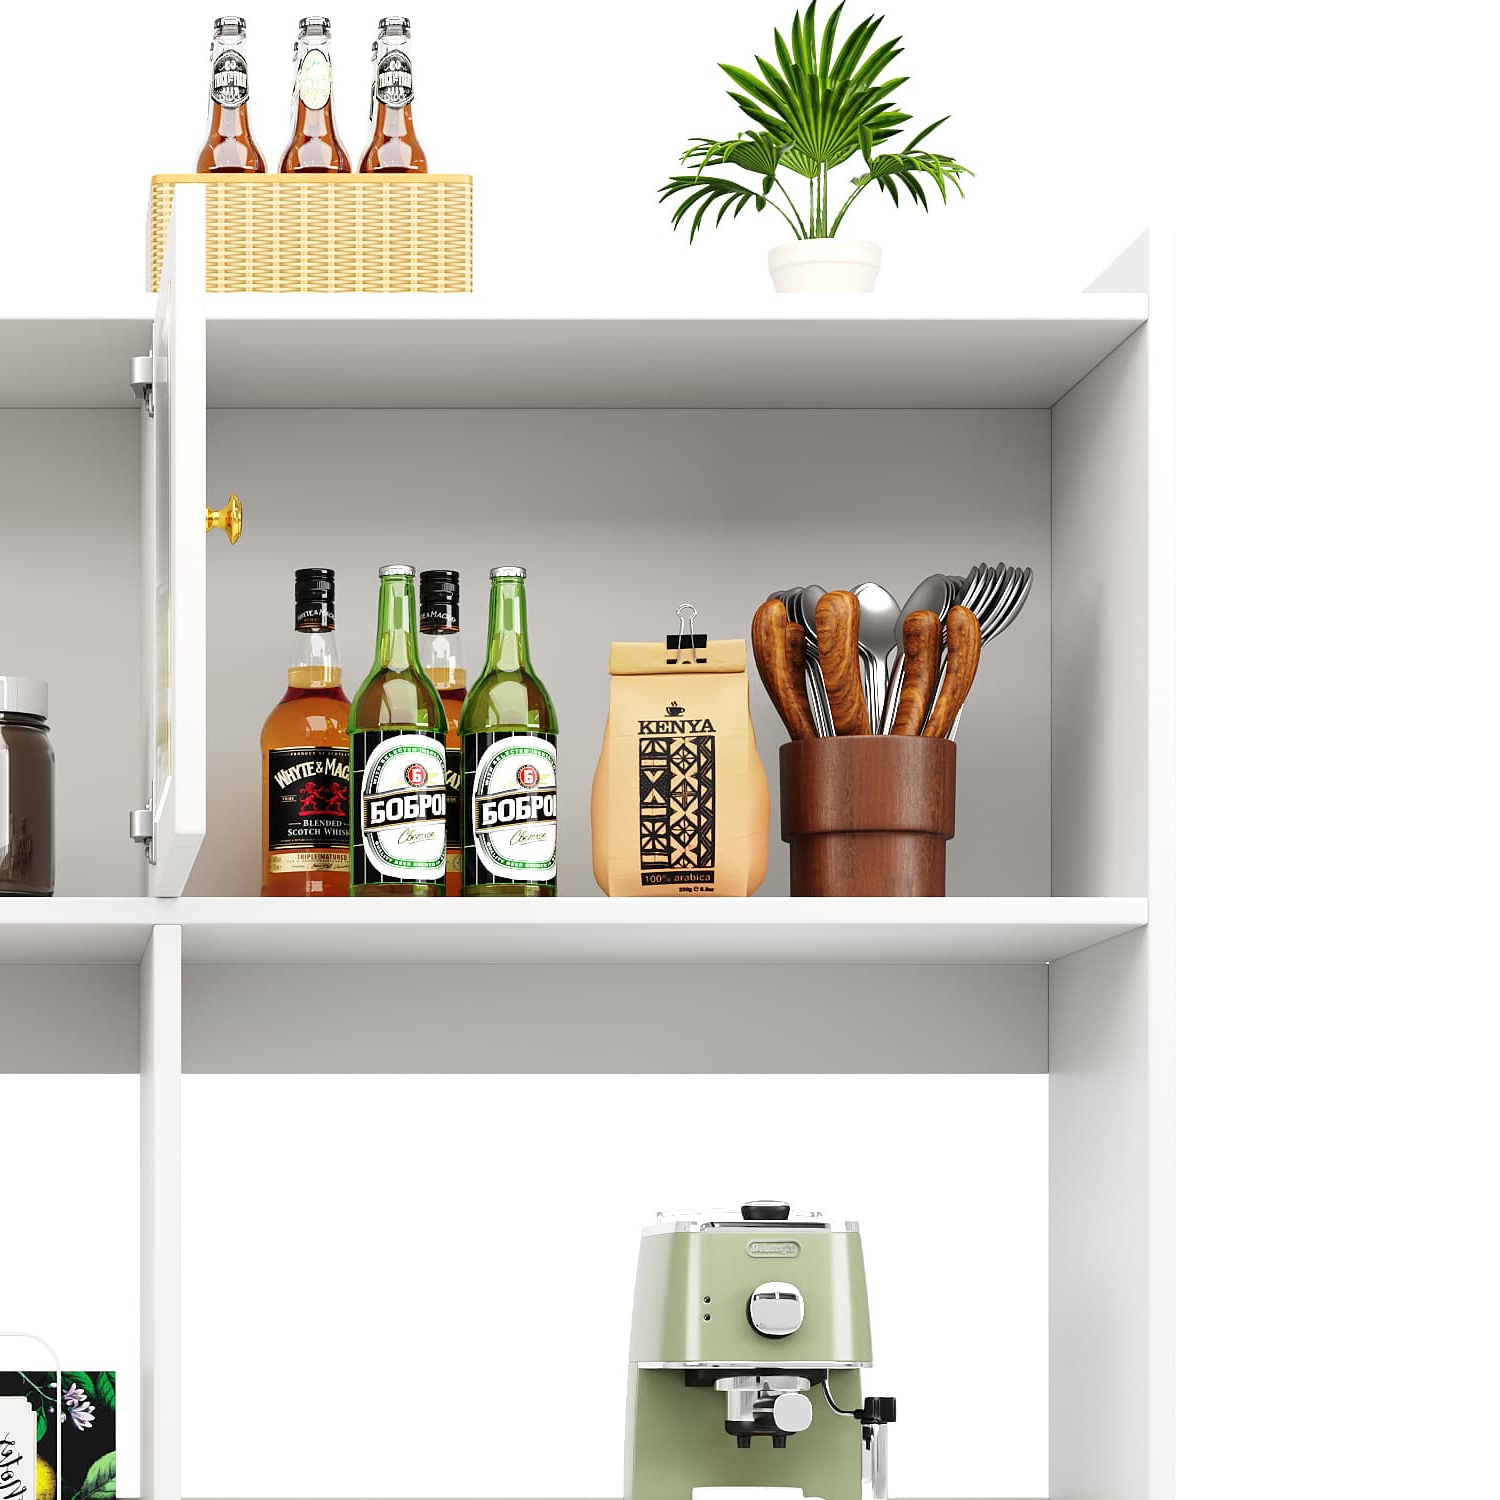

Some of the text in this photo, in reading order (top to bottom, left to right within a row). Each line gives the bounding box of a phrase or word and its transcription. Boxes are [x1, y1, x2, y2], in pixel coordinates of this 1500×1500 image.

[637, 718, 716, 736] KENYA
[274, 758, 350, 790] WHYTE & MAC
[303, 819, 342, 827] BLENDED
[287, 828, 350, 837] SCOTCH WHISK
[297, 853, 319, 861] TRIPLE
[320, 853, 348, 861] MATURED
[644, 873, 711, 883] 100% arabica
